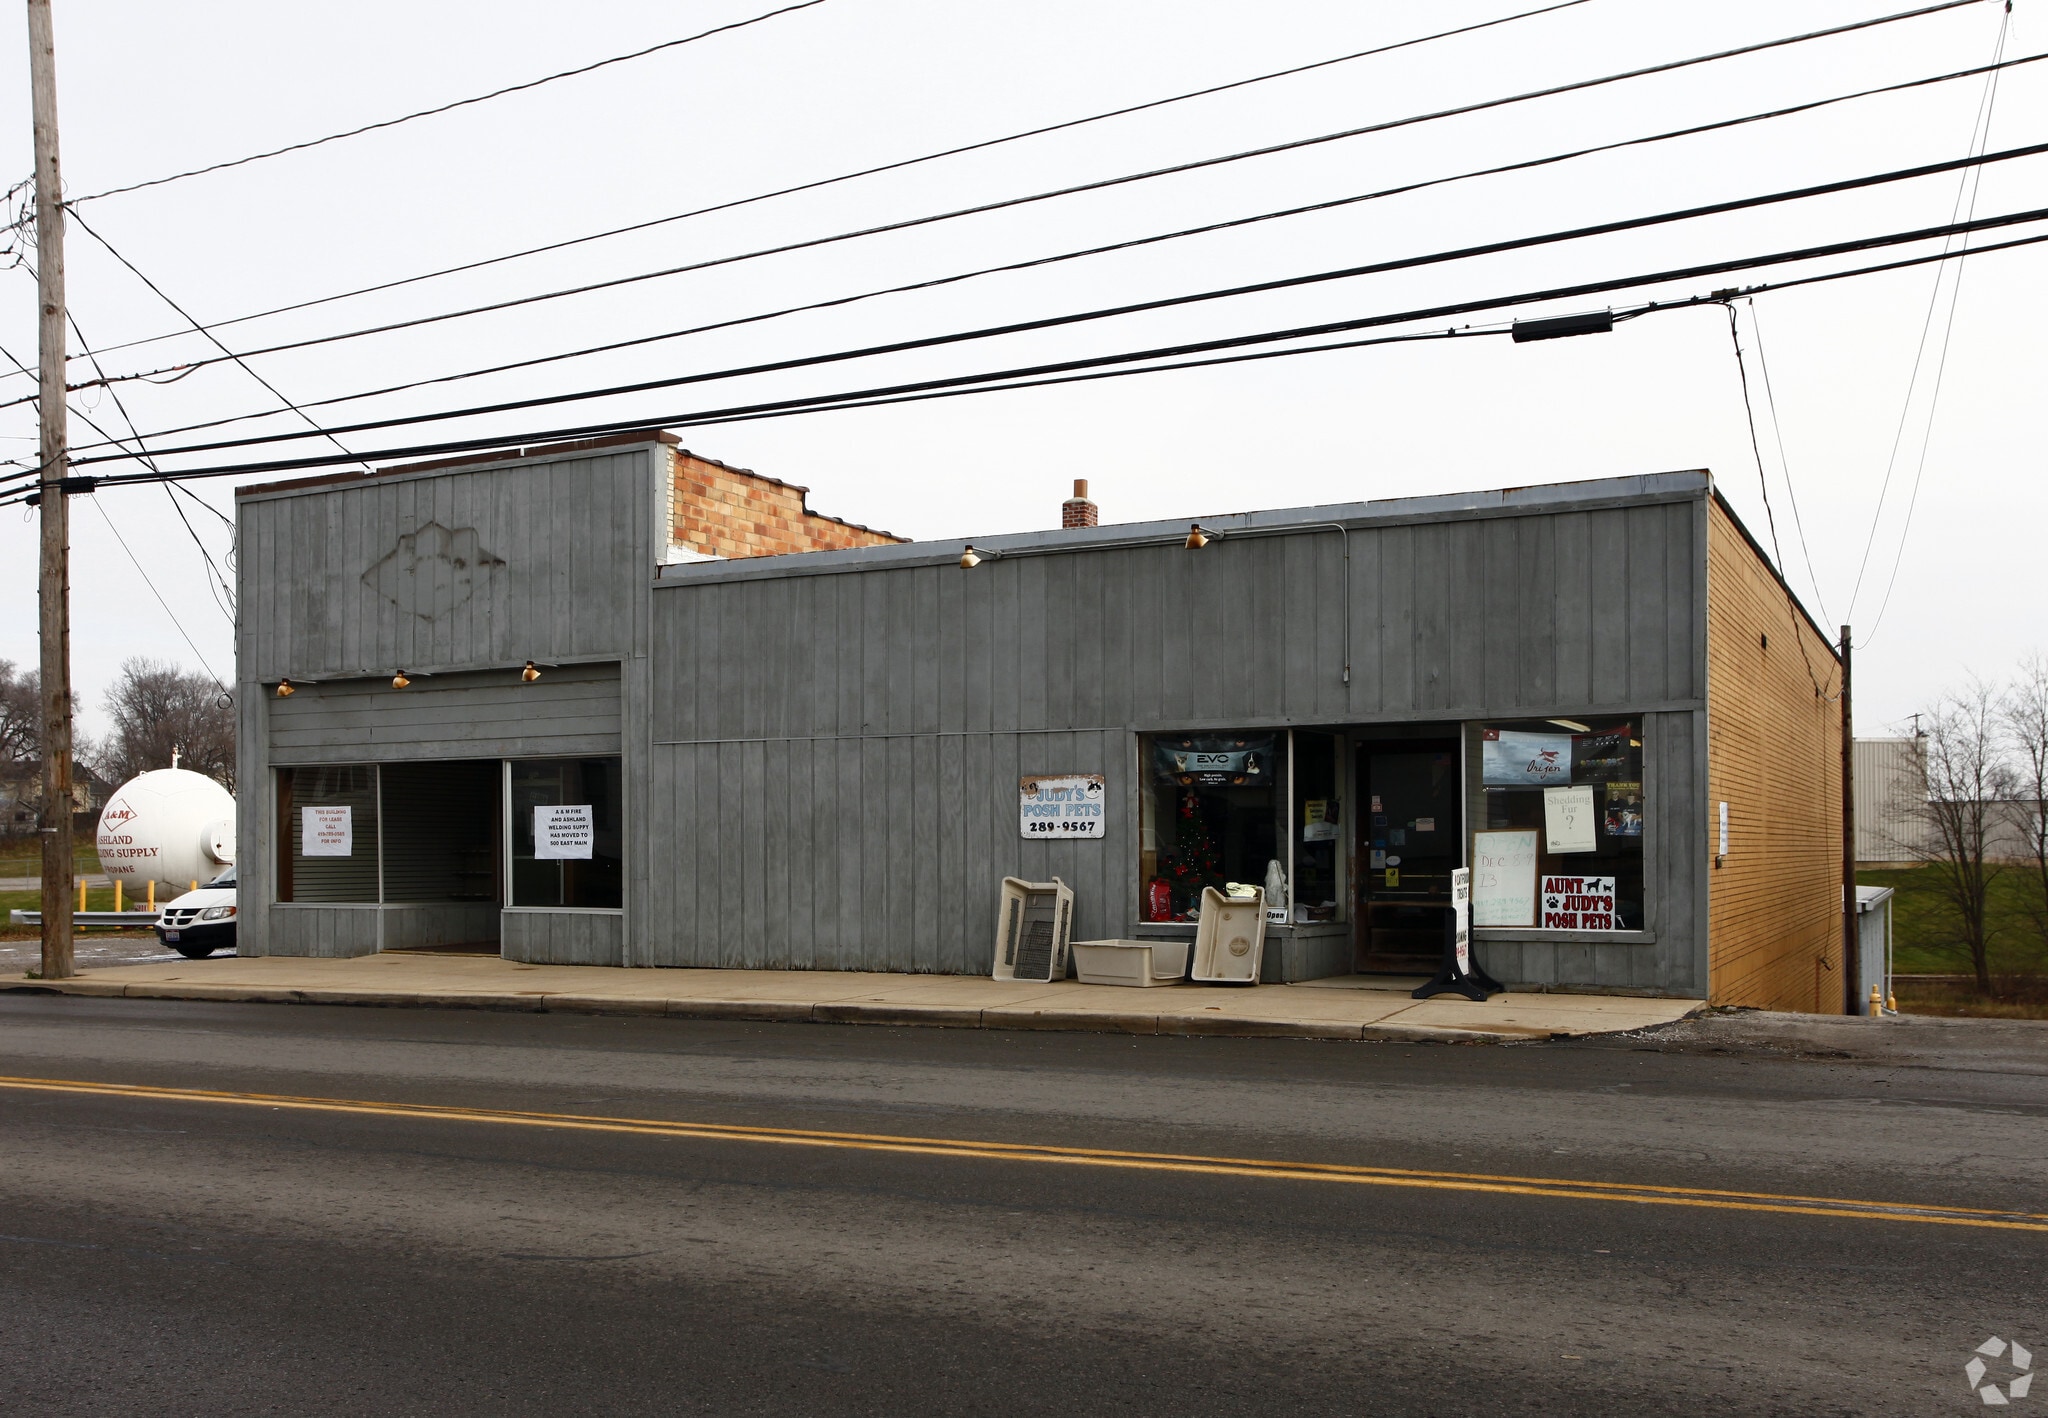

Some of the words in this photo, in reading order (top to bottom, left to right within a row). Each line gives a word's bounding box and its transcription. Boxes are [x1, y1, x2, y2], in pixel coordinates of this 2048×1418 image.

[1197, 754, 1229, 763] EVO
[1526, 760, 1561, 780] Orijen
[1036, 784, 1084, 801] JUDY'S
[1548, 796, 1591, 805] Shedding
[105, 810, 130, 820] A&M
[1024, 804, 1060, 817] POSH
[1066, 803, 1101, 816] PETS
[1566, 815, 1574, 830] ?
[117, 848, 159, 857] SUPPLY
[1545, 878, 1584, 894] AUNT
[1562, 896, 1613, 912] JUDY'S
[1545, 913, 1577, 928] POSH
[1582, 913, 1612, 929] PETS
